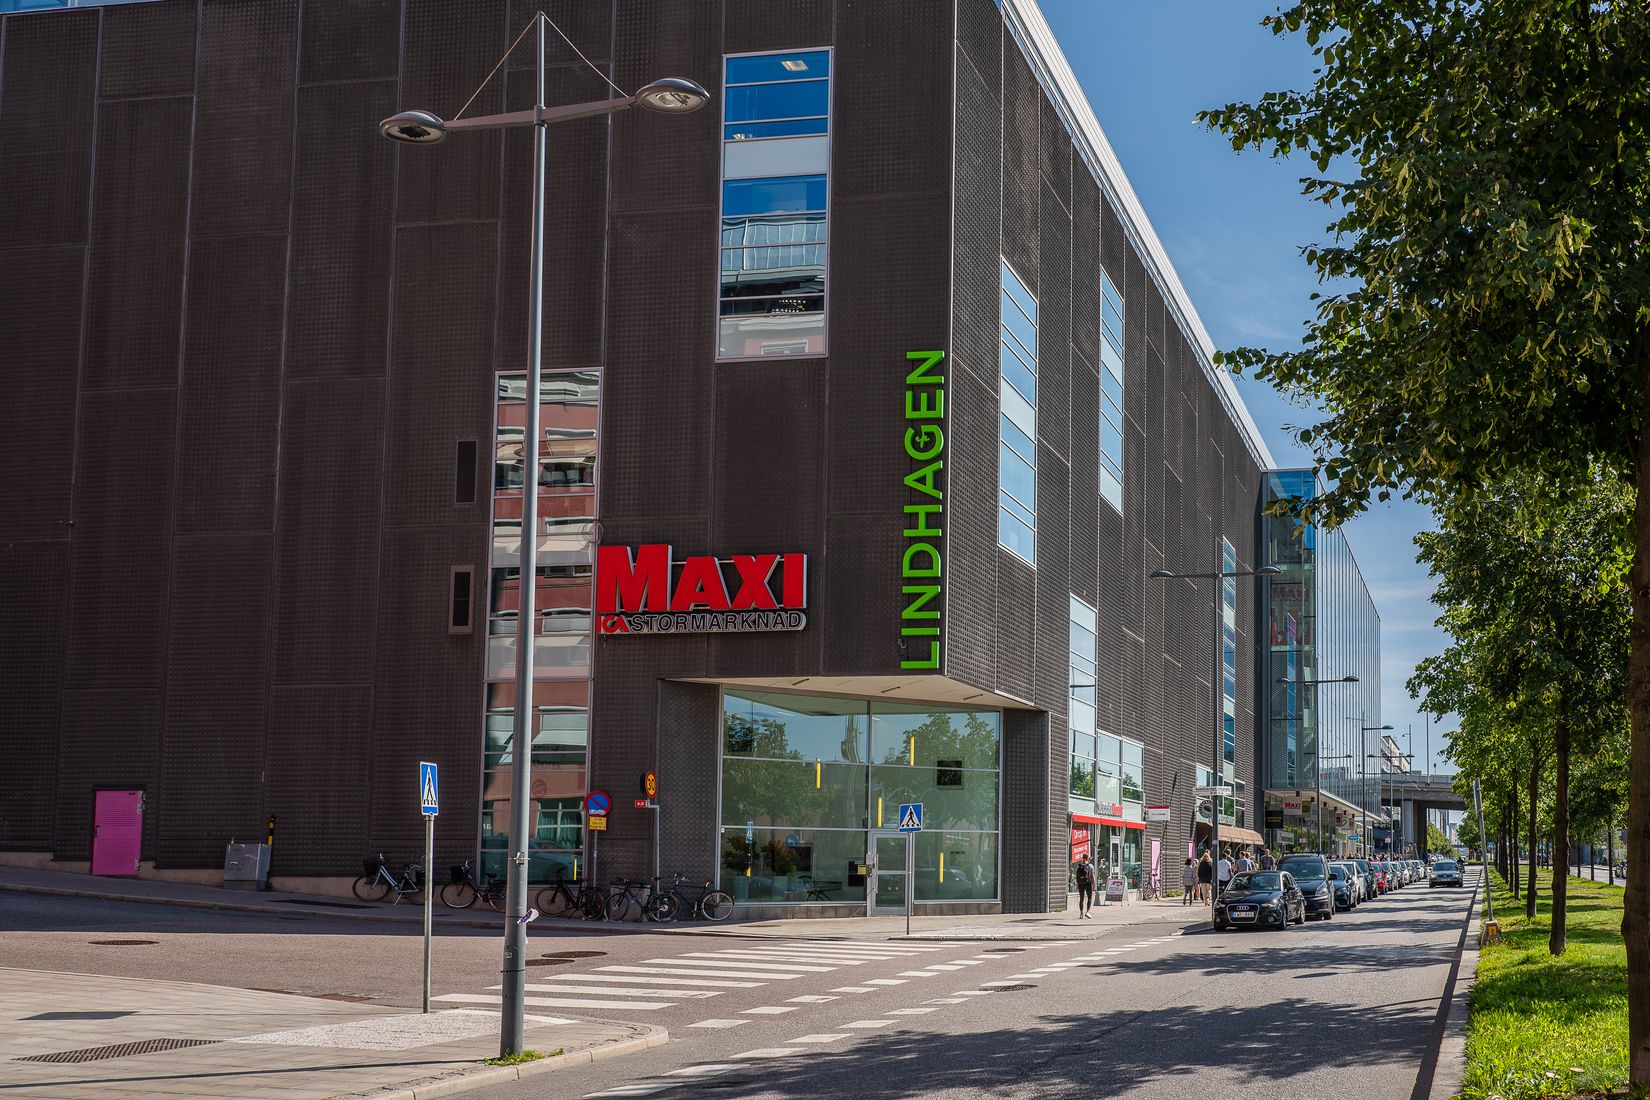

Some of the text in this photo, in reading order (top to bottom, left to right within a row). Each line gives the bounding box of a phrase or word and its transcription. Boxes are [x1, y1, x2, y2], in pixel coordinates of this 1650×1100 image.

[900, 350, 945, 669] LINDHAGEN
[597, 543, 807, 613] MAXI
[595, 610, 806, 633] ICA STORMARKNAD
